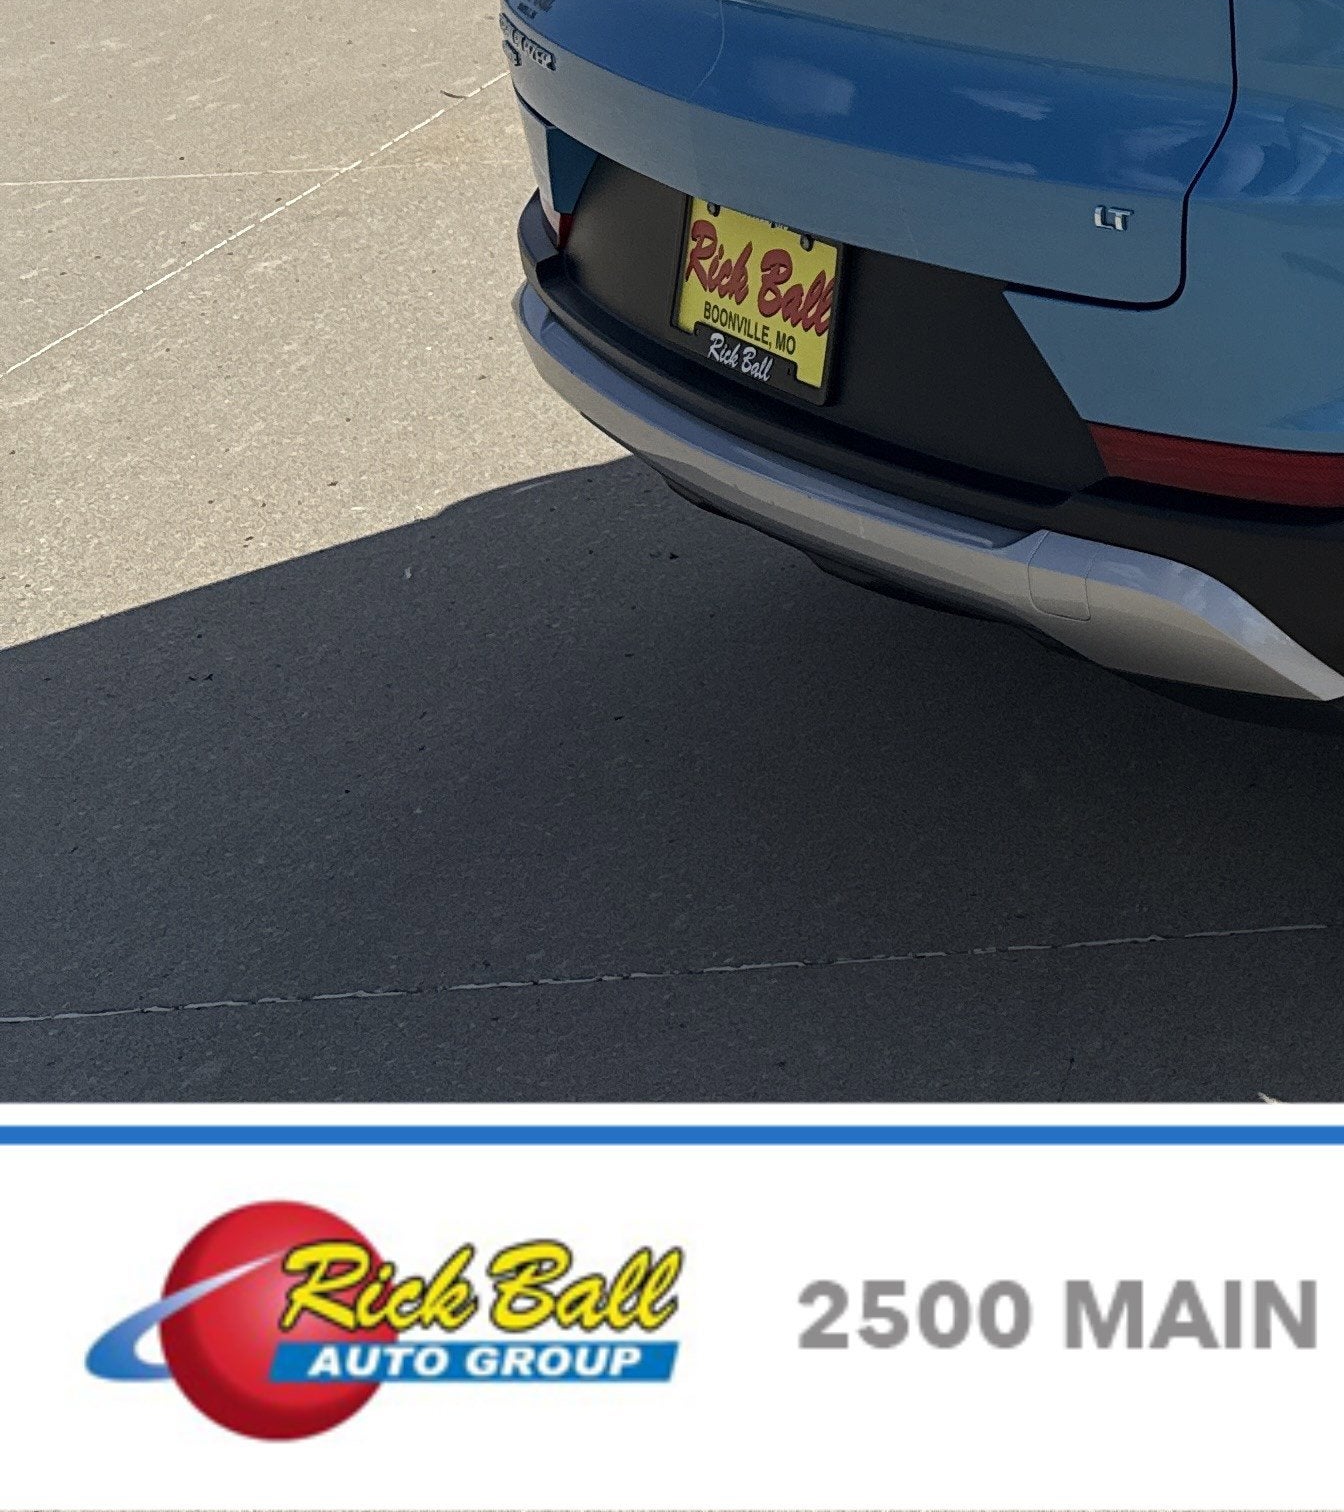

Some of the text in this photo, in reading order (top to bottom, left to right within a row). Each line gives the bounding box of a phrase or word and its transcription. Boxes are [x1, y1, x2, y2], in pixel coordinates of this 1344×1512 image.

[1094, 205, 1133, 231] LT
[685, 219, 836, 338] Rick Ball
[703, 300, 797, 356] BOONVILLE, MO
[706, 332, 774, 383] Rick Ball
